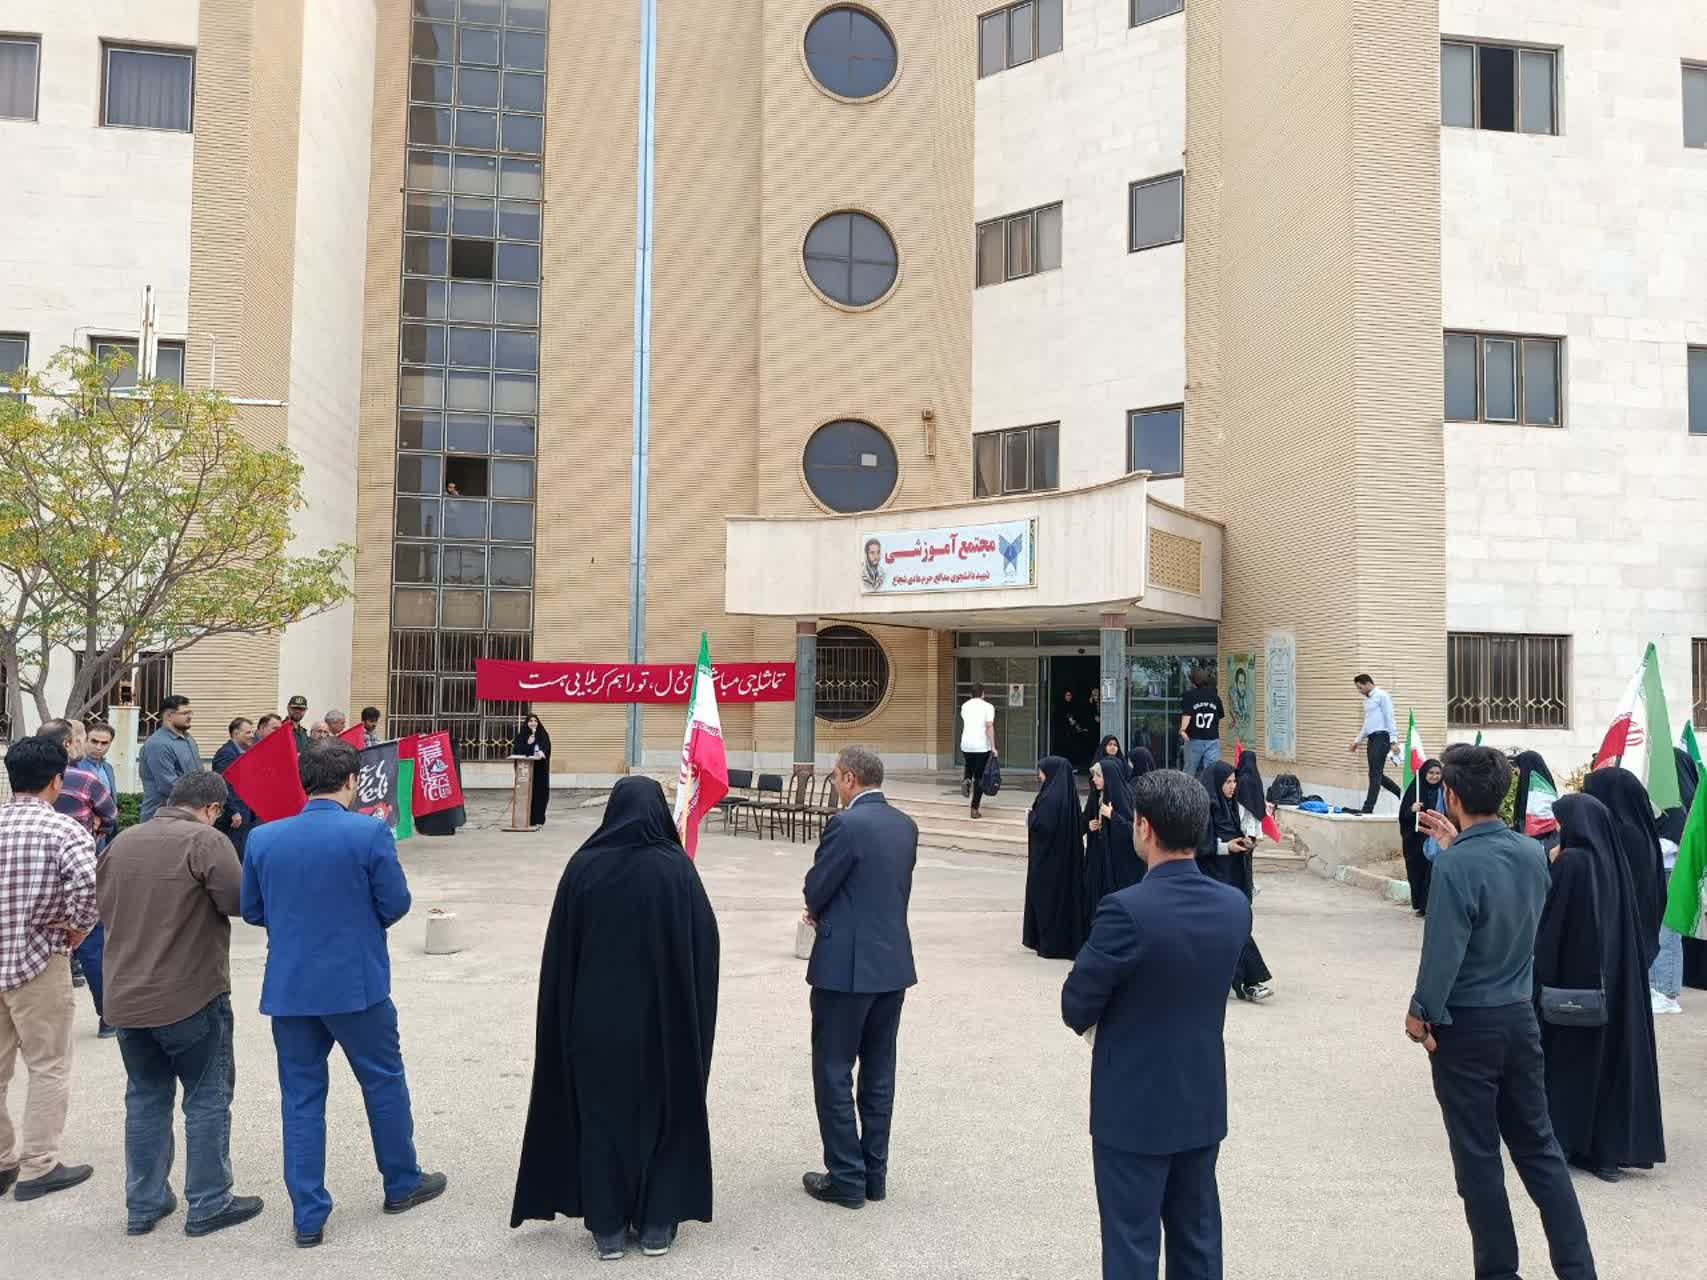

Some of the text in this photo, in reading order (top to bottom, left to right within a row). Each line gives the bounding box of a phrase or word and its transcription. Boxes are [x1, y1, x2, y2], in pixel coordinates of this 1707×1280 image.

[884, 533, 996, 564] مجتمع آموزشی
[518, 672, 569, 689] هست
[565, 667, 618, 697] کربلایی
[738, 670, 787, 697] تماشاچی
[1196, 713, 1214, 729] 07
